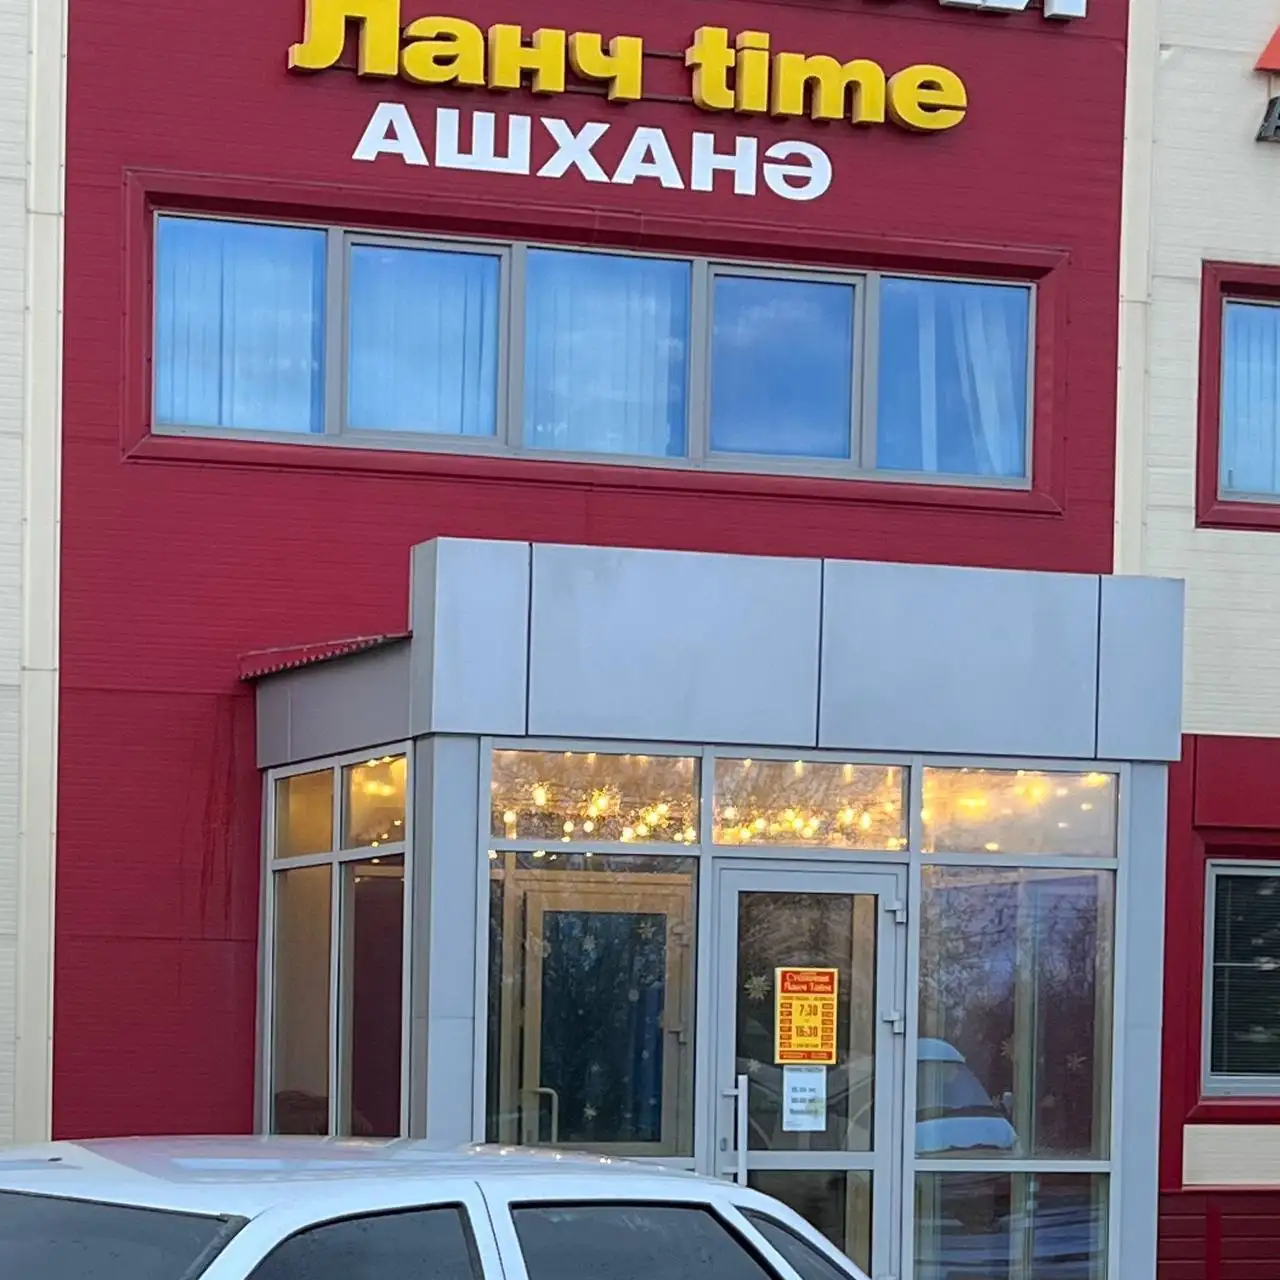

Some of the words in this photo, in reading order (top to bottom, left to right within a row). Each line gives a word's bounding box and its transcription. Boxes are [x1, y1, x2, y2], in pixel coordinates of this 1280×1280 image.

[288, 0, 643, 100] Ланч
[685, 26, 968, 131] time
[351, 102, 833, 200] АШХАНӘ
